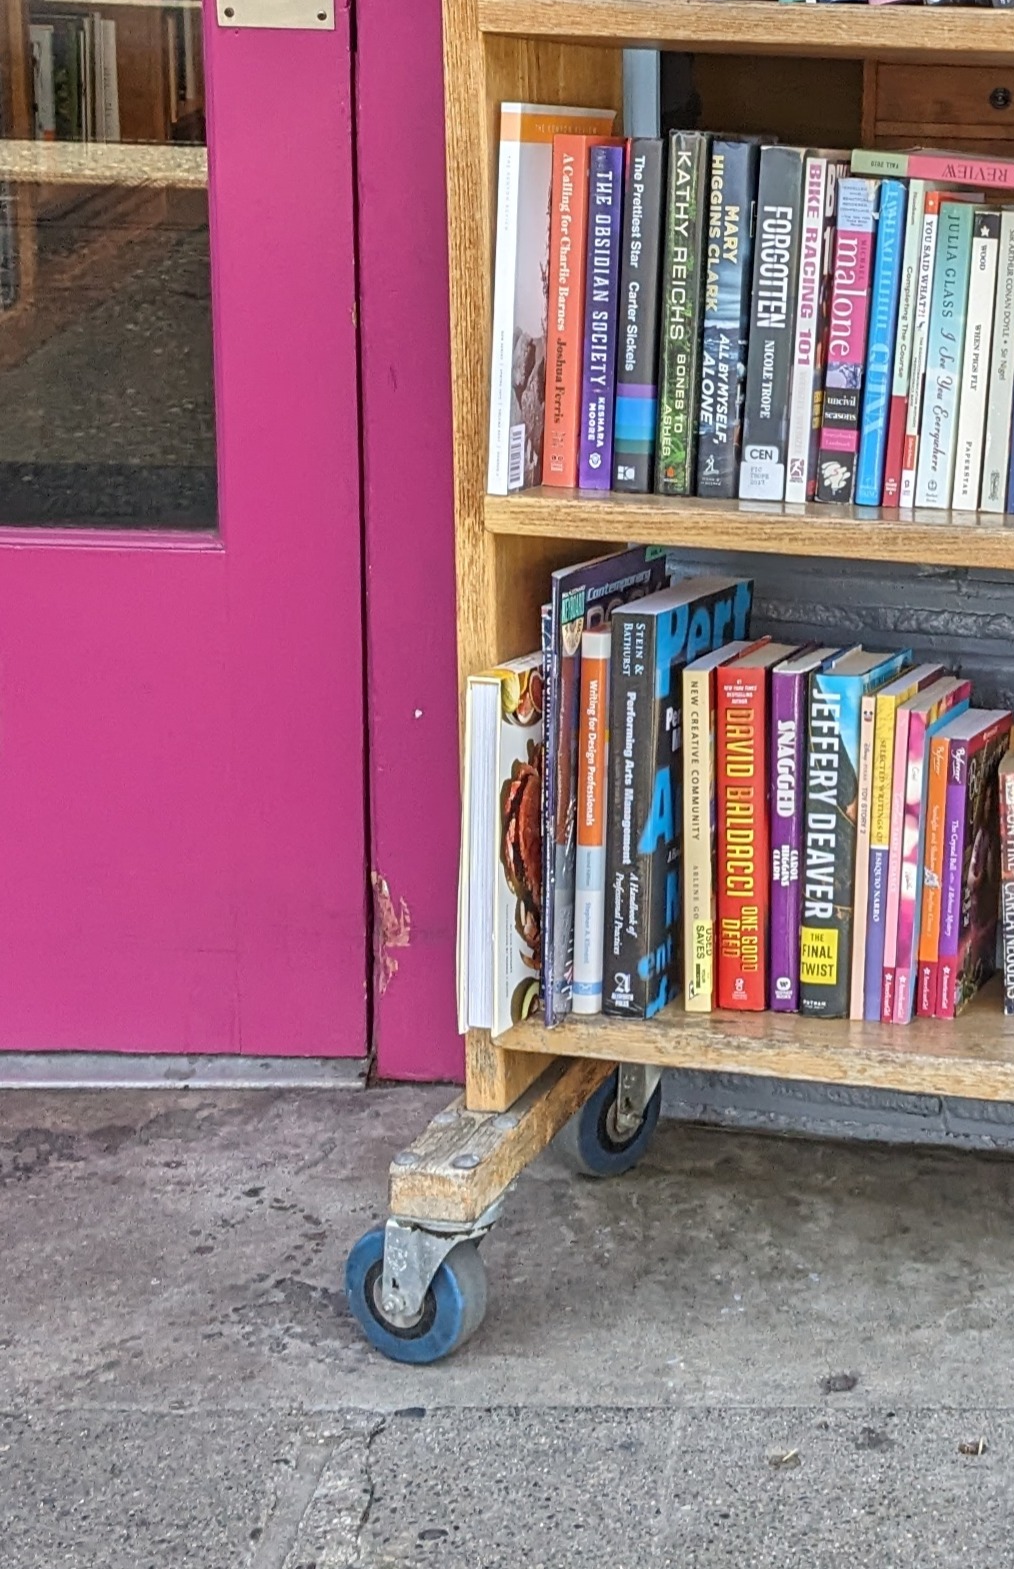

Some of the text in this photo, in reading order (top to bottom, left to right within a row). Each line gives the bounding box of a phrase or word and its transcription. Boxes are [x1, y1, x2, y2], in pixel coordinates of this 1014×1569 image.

[629, 155, 646, 268] The Prettiest Star
[670, 151, 692, 341] KATHY REICHS
[705, 155, 724, 312] HIGGINS CLARK
[723, 205, 740, 264] MARY
[589, 171, 613, 386] THE OBSIDIAN SOCIETY
[797, 163, 823, 367] BIKE RACING 101
[829, 237, 867, 357] malone
[941, 215, 960, 319] JULIA GLASS
[625, 282, 640, 371] Carter Sickels
[824, 412, 857, 422] seasons
[827, 396, 856, 407] uncivil
[750, 448, 773, 460] CEN
[725, 709, 754, 897] DAVID BALDACCI
[804, 688, 841, 920] JEFFERY DEAVER
[801, 944, 833, 959] FINAL
[801, 962, 835, 978] TWIST
[810, 932, 825, 942] THE
